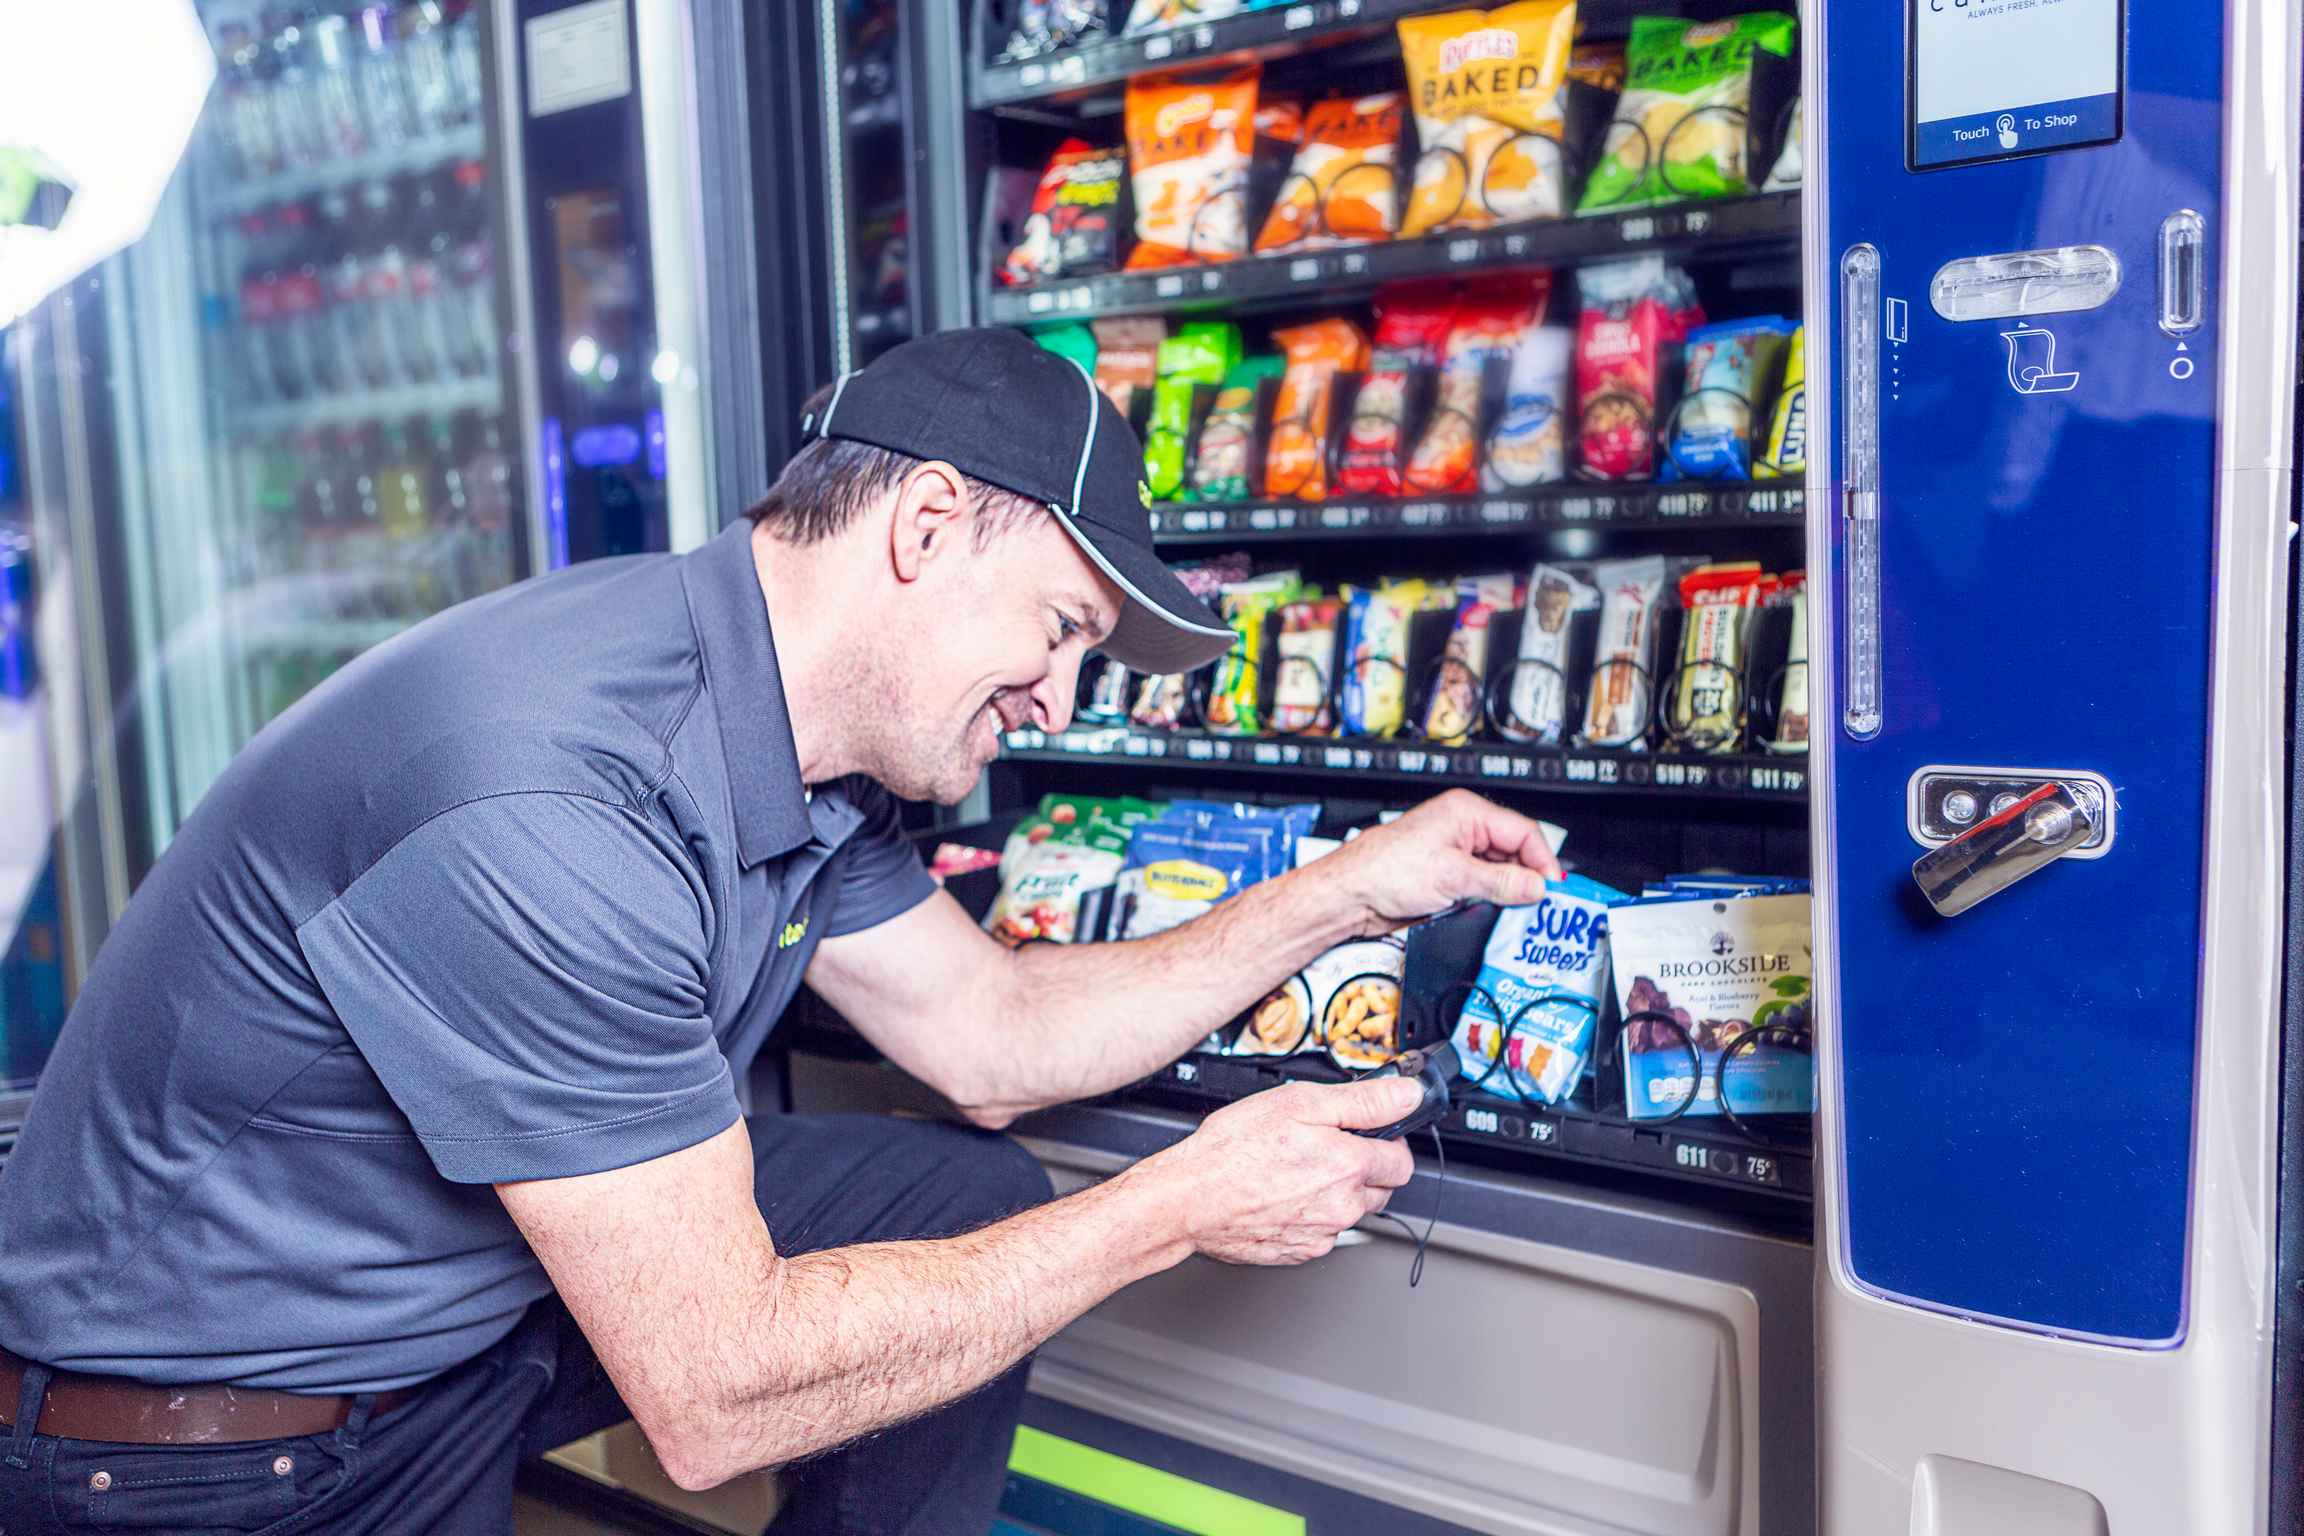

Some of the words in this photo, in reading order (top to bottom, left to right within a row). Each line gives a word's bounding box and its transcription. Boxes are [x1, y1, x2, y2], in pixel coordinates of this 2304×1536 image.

[1968, 5, 2004, 19] ALWAYS
[1422, 64, 1540, 107] BAKED
[1953, 126, 1989, 141] Touch
[2024, 119, 2041, 130] To
[2044, 114, 2078, 128] Shop
[1749, 490, 1777, 513] 411
[1751, 767, 1780, 789] 511
[1660, 954, 1791, 978] BROOKSIDE
[1530, 1121, 1553, 1141] 75¢
[1676, 1143, 1708, 1169] 611
[1746, 1156, 1771, 1177] 75¢
